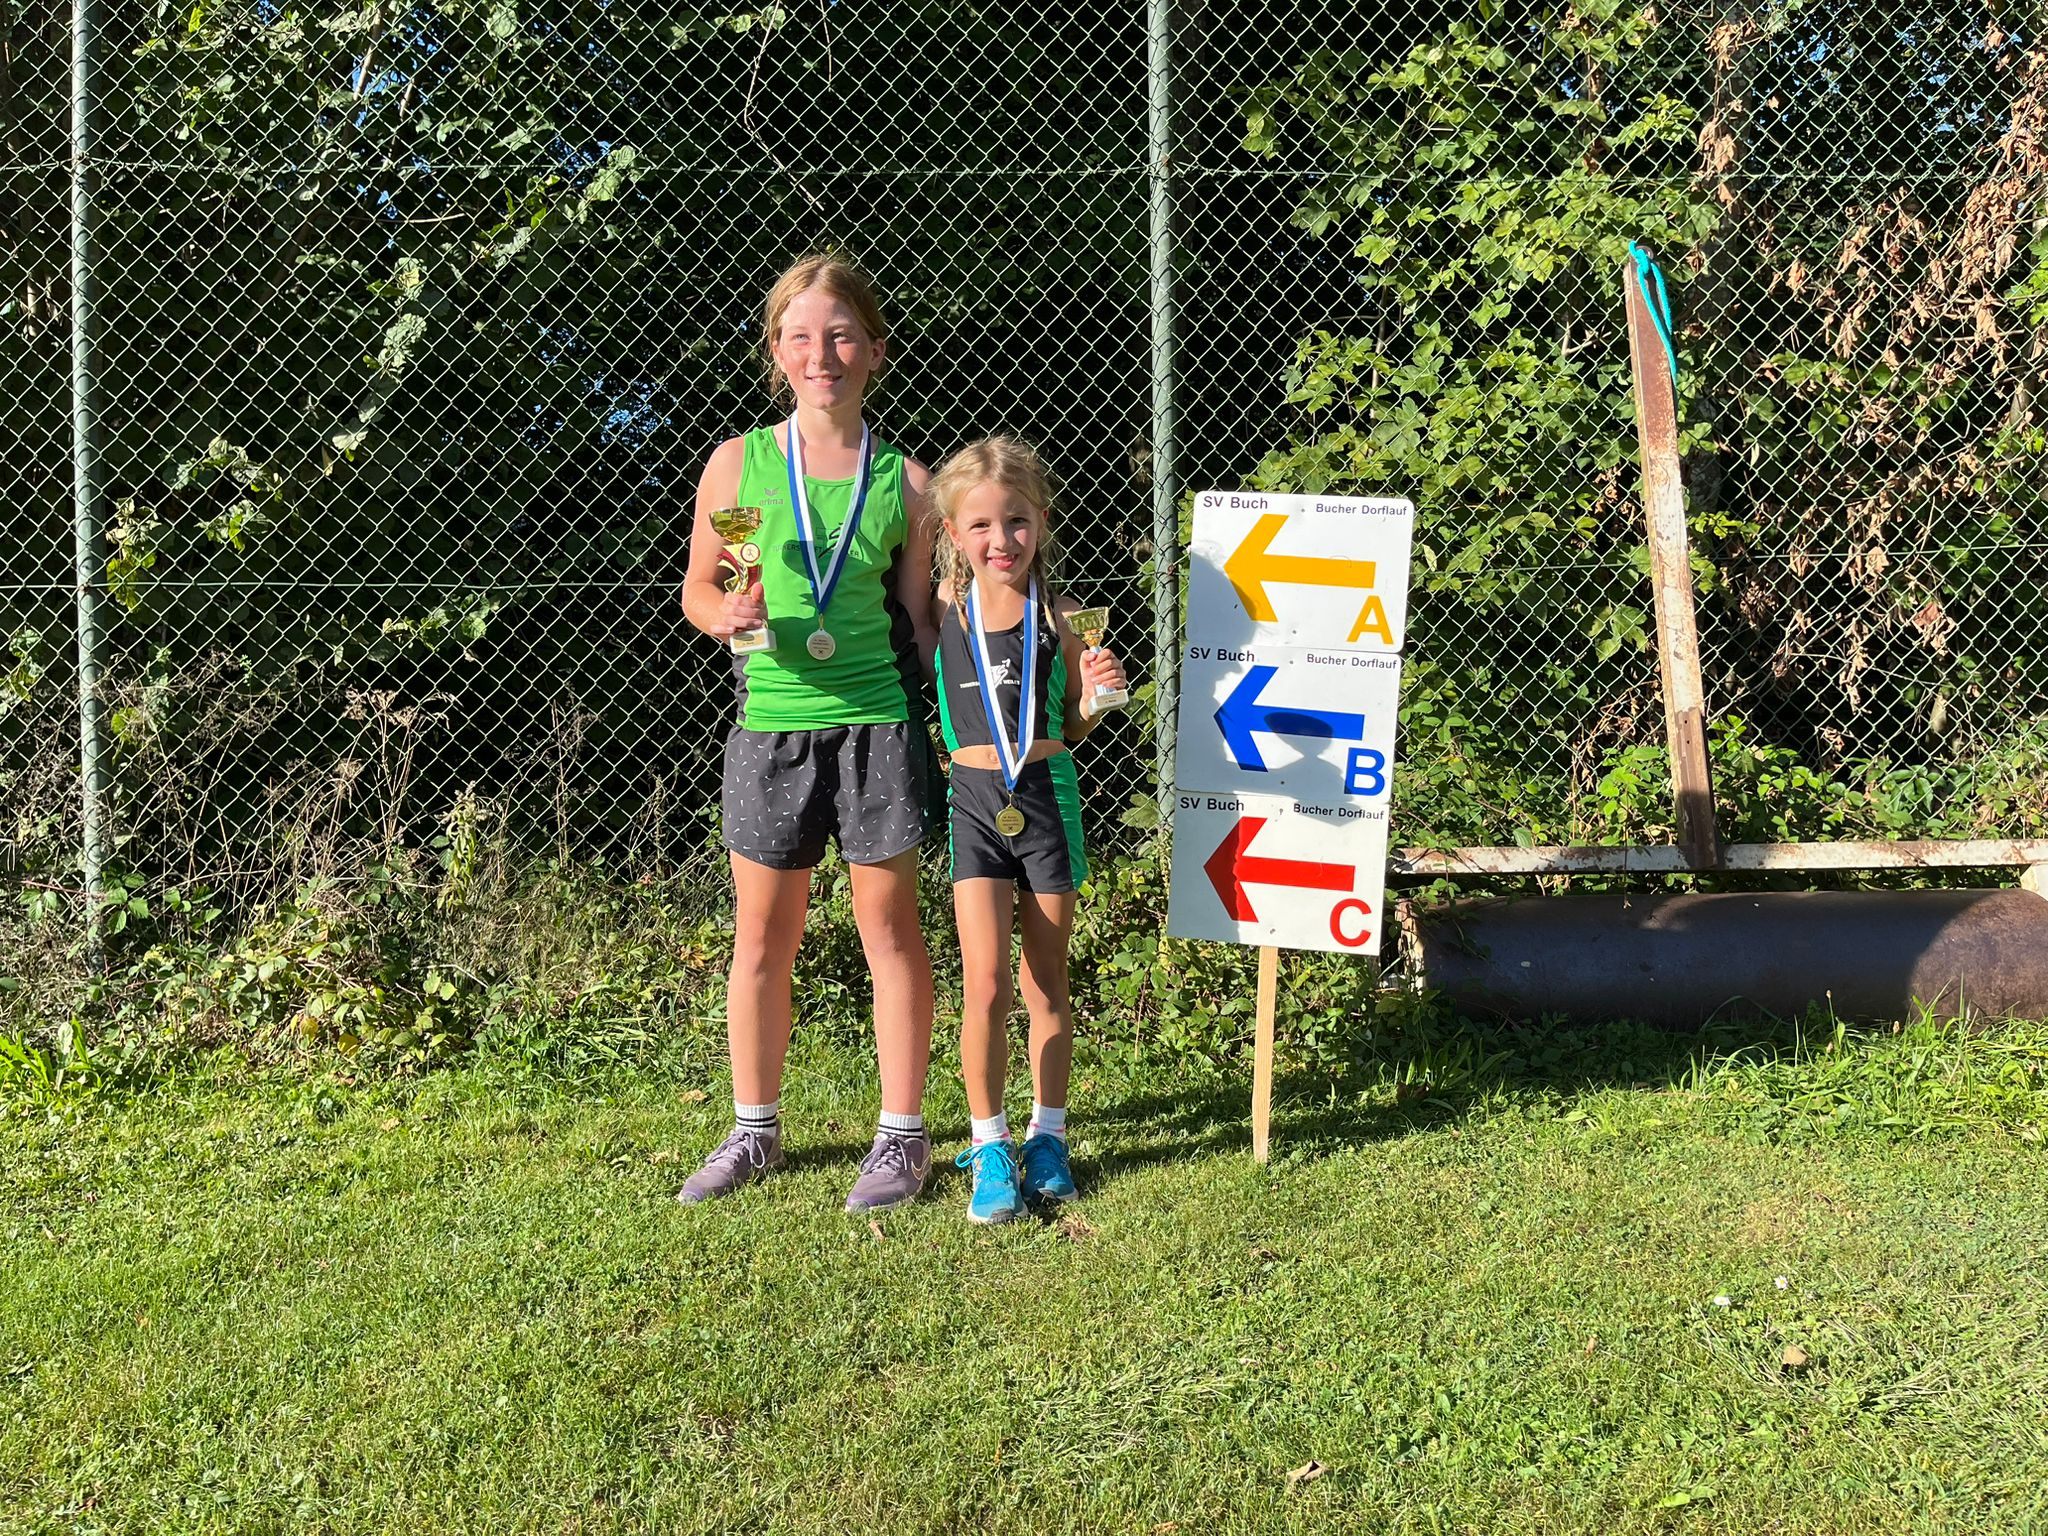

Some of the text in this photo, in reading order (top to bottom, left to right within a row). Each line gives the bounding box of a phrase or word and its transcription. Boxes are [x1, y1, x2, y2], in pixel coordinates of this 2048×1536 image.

[1203, 496, 1268, 510] SV Buch
[1316, 503, 1407, 516] Bucher Dorflauf
[1346, 595, 1394, 645] A
[1189, 647, 1255, 662] SV Buch
[1307, 653, 1397, 669] Bucher Dorflauf
[1343, 747, 1385, 796] B
[1180, 797, 1244, 812] SV Buch
[1293, 803, 1384, 820] Bucher Dorflauf
[1329, 898, 1372, 947] C
